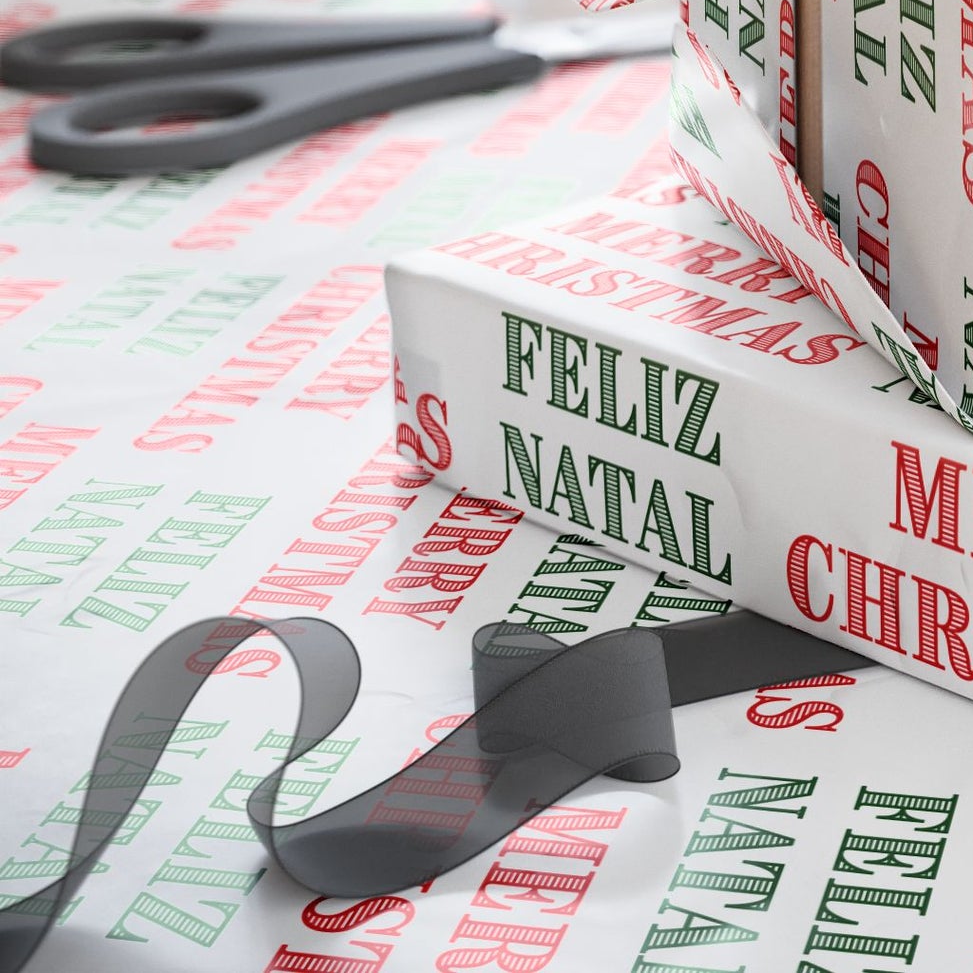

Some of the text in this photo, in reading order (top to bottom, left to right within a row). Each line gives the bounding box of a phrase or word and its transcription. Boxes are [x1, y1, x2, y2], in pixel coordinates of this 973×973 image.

[500, 311, 722, 466] FELIZ
[59, 489, 273, 633] FELIZ
[498, 420, 733, 587] NATAL
[104, 728, 362, 949] FELIZ
[797, 784, 960, 973] FELI
